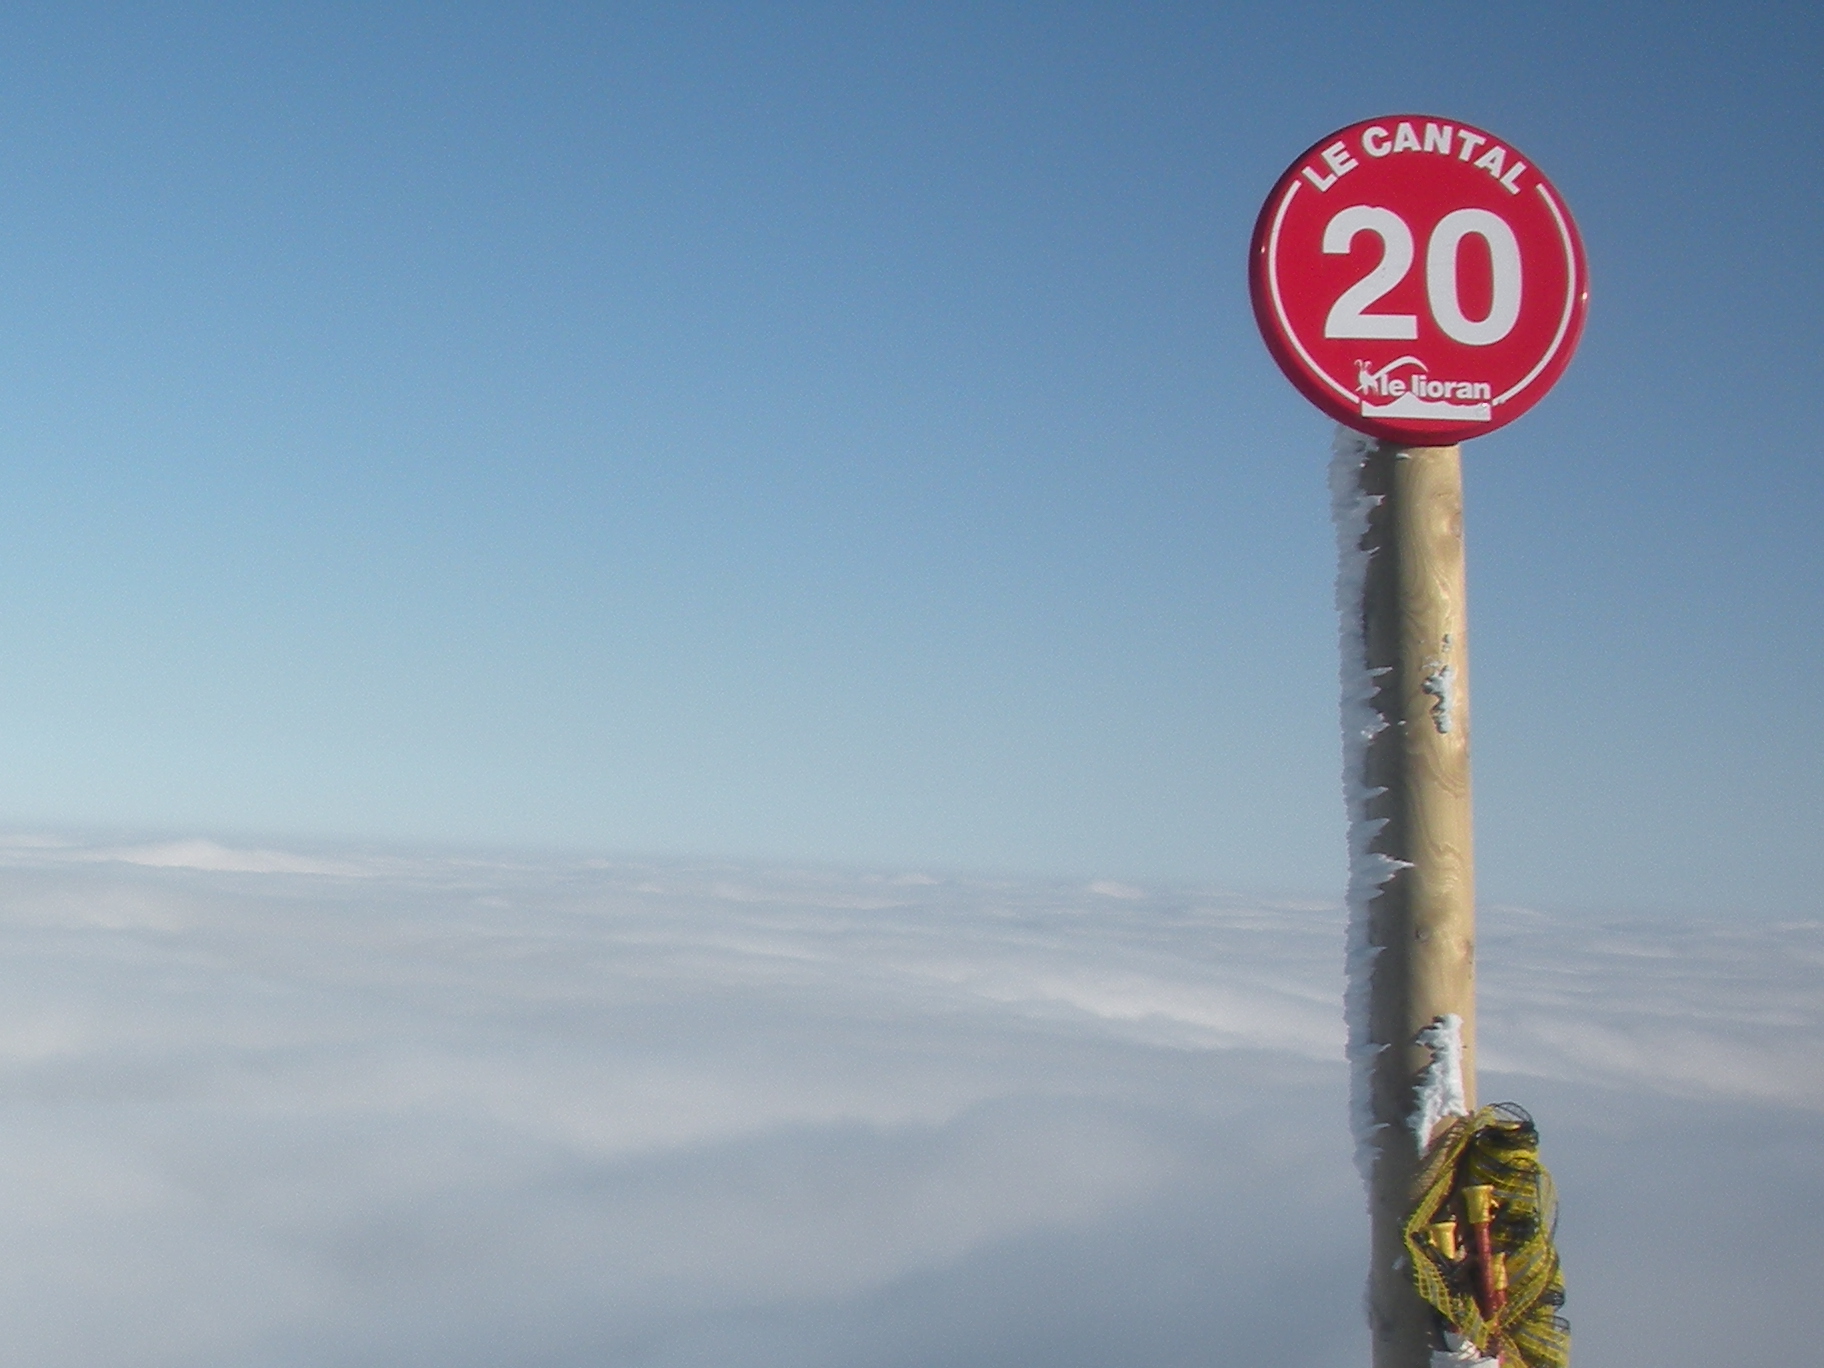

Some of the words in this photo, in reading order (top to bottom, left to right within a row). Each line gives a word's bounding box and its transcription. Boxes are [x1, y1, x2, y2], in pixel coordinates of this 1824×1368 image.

[1302, 141, 1359, 193] LE
[1362, 122, 1527, 195] CANTAL
[1322, 204, 1523, 346] 20
[1380, 373, 1406, 396] le
[1411, 374, 1491, 399] lioran
